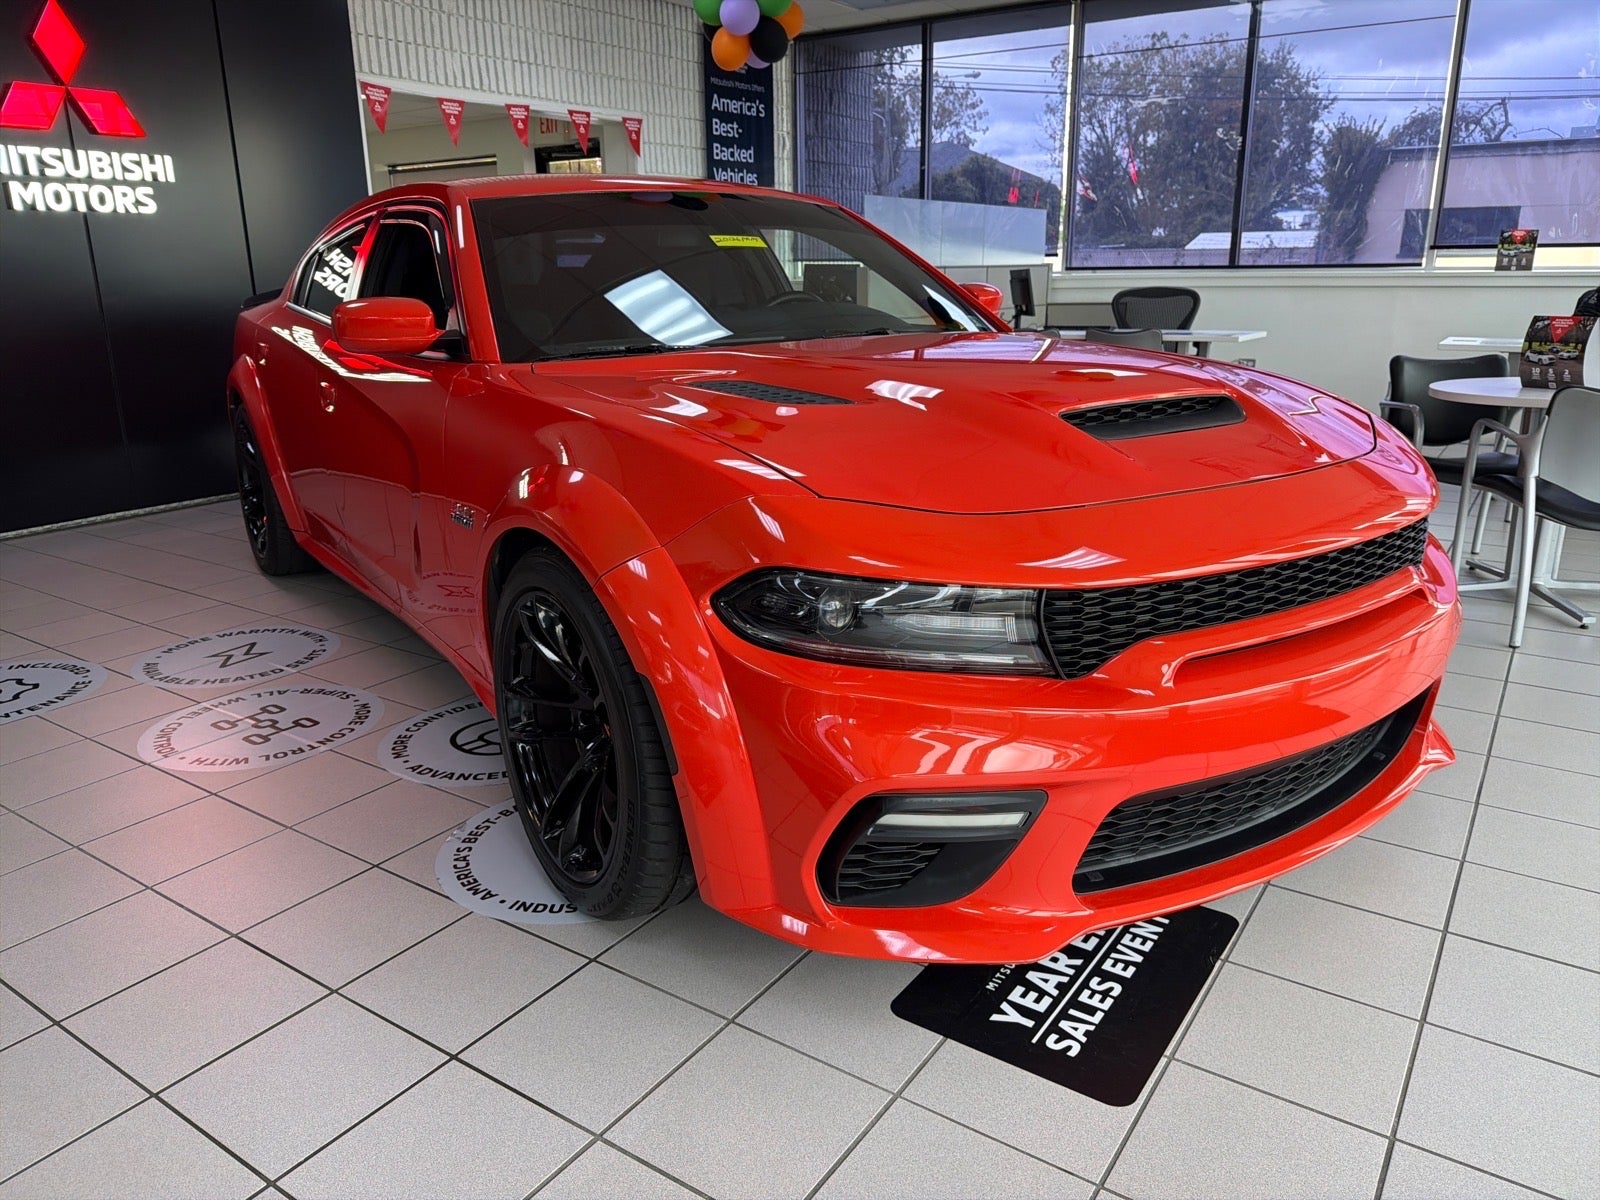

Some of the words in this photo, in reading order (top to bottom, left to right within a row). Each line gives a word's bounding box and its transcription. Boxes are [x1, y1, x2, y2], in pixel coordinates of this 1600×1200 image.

[711, 93, 766, 117] America's
[712, 118, 743, 138] Best-
[0, 143, 176, 183] ITSUBISHI
[713, 143, 754, 163] Backed
[713, 167, 758, 186] Vehicles
[8, 181, 158, 214] MOTORS
[161, 636, 213, 653] MORE
[216, 628, 300, 638] WARMTH
[299, 630, 328, 643] WITH
[7, 662, 91, 675] INCLUDED
[202, 668, 285, 685] HEATED
[285, 649, 327, 668] SEATS
[251, 688, 356, 700] SUPER-ALL
[176, 696, 247, 720] WHEEL
[348, 702, 371, 726] MORE
[153, 722, 183, 758] CONTROL
[391, 734, 414, 759] MORE
[405, 702, 483, 732] CONFIDE
[258, 727, 355, 761] CONTROL
[189, 757, 249, 766] WITH
[453, 847, 499, 900] AMERICA'S
[989, 951, 1084, 1028] YEAR
[1045, 976, 1122, 1058] SALES
